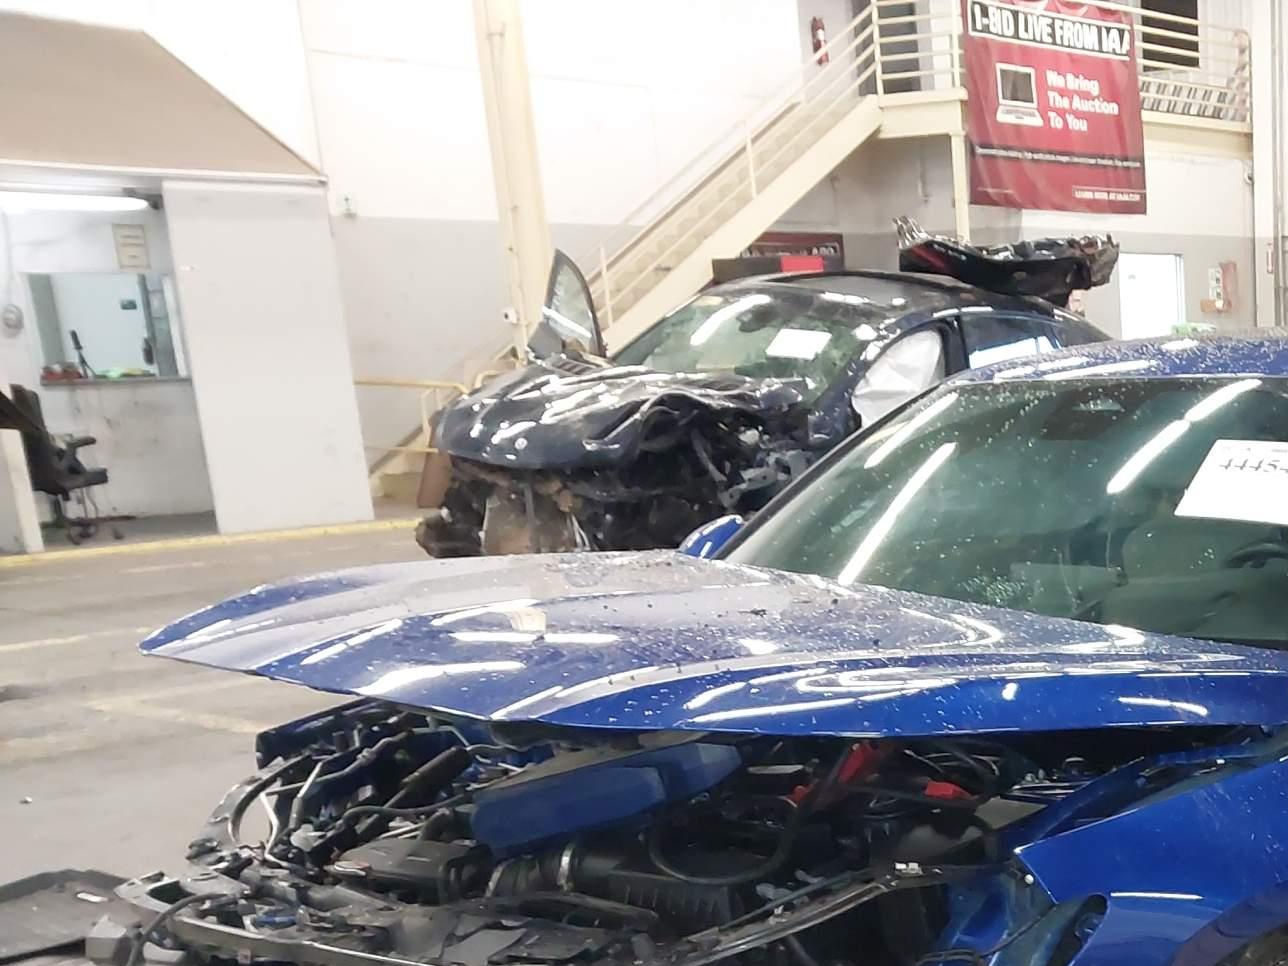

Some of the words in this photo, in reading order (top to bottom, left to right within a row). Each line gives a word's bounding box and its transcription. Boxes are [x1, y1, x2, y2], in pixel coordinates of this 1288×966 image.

[1018, 12, 1053, 43] LIVE
[1054, 18, 1100, 51] FROM
[1046, 69, 1065, 88] We
[1066, 72, 1100, 97] Bring
[1047, 90, 1070, 110] The
[1072, 94, 1120, 116] Auction
[1047, 111, 1064, 130] To
[1065, 112, 1088, 132] You
